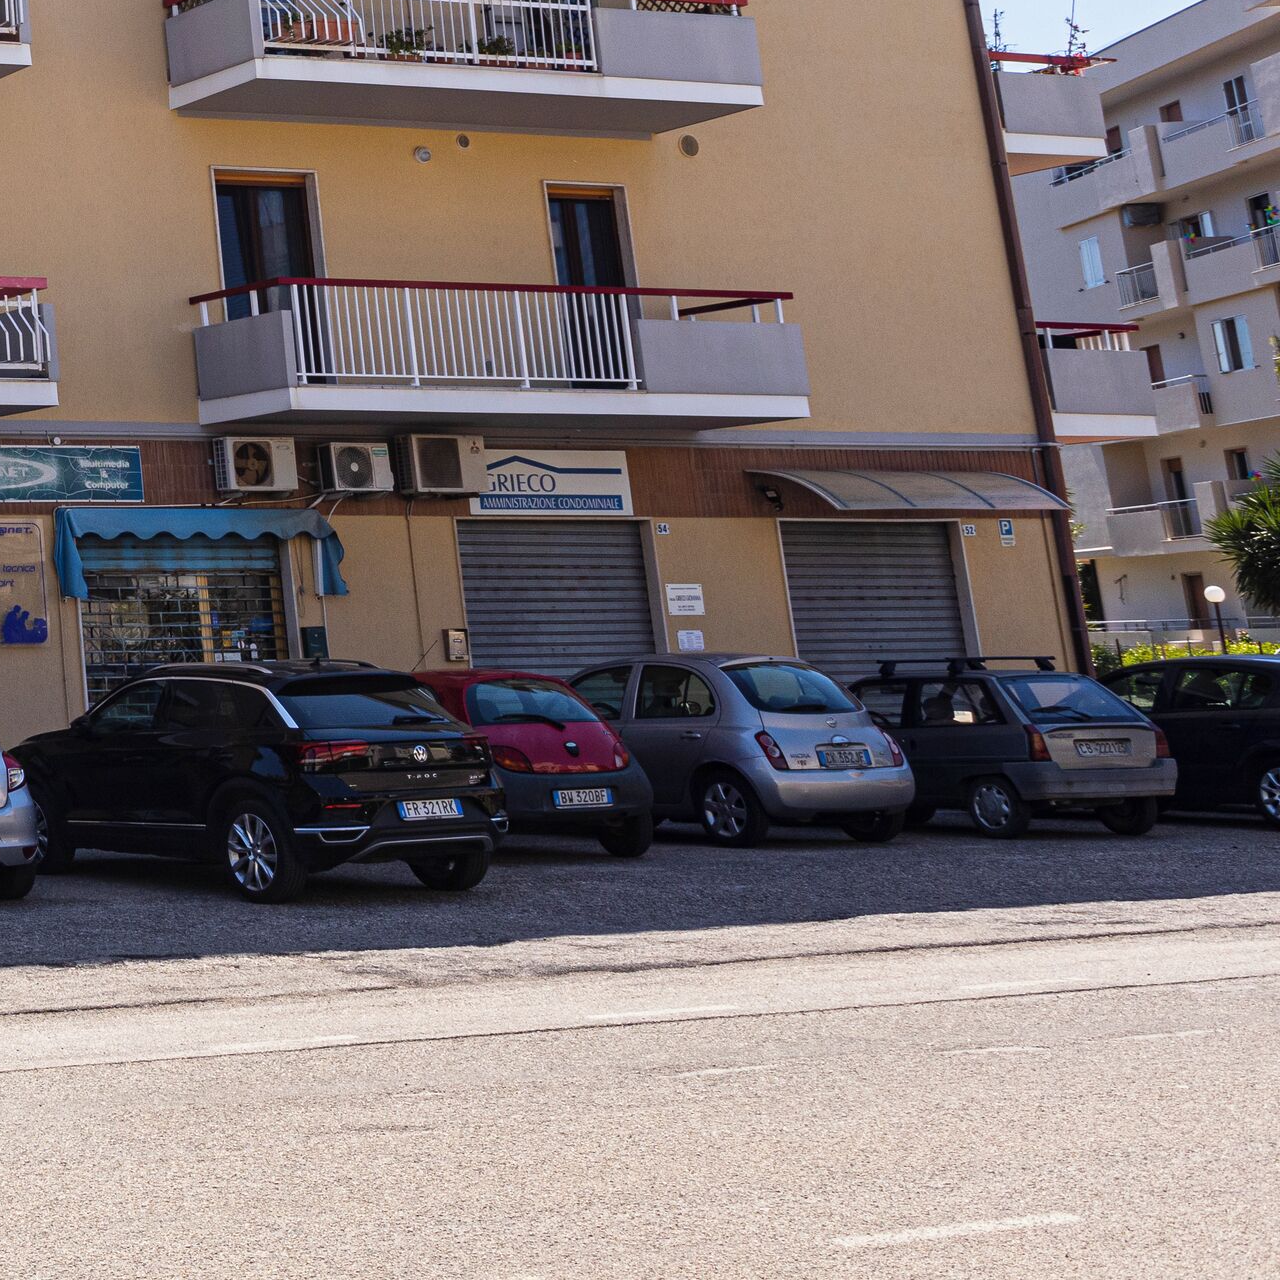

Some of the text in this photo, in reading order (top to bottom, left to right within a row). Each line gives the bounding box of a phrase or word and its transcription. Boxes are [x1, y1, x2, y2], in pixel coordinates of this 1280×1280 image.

[80, 459, 130, 468] Multimedia
[85, 480, 129, 490] Computer
[482, 497, 620, 509] AMMINISTRAZIONE CONDOMINIALE
[657, 524, 668, 533] 54
[965, 526, 975, 535] 52
[2, 564, 36, 573] tecnica
